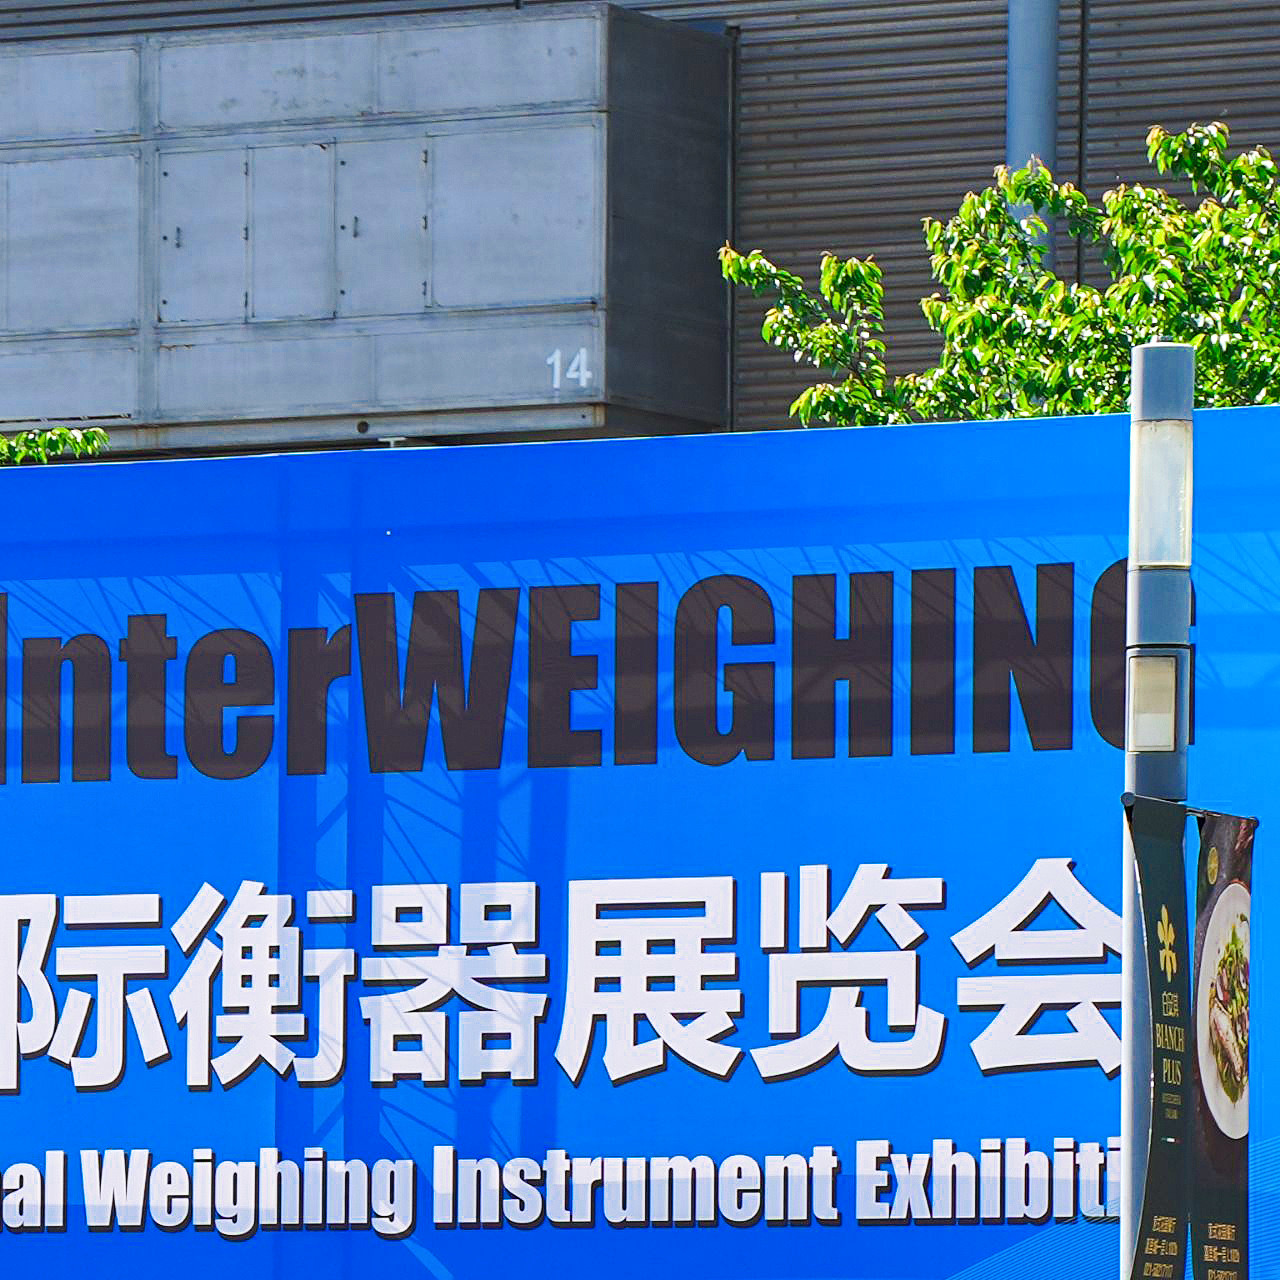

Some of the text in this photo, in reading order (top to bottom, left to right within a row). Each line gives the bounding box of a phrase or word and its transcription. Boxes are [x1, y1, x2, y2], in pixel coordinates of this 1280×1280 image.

[544, 347, 592, 389] 14
[80, 1146, 416, 1240] Weighing
[434, 1144, 841, 1227] Instrument
[857, 1136, 1121, 1224] Exhibiti
